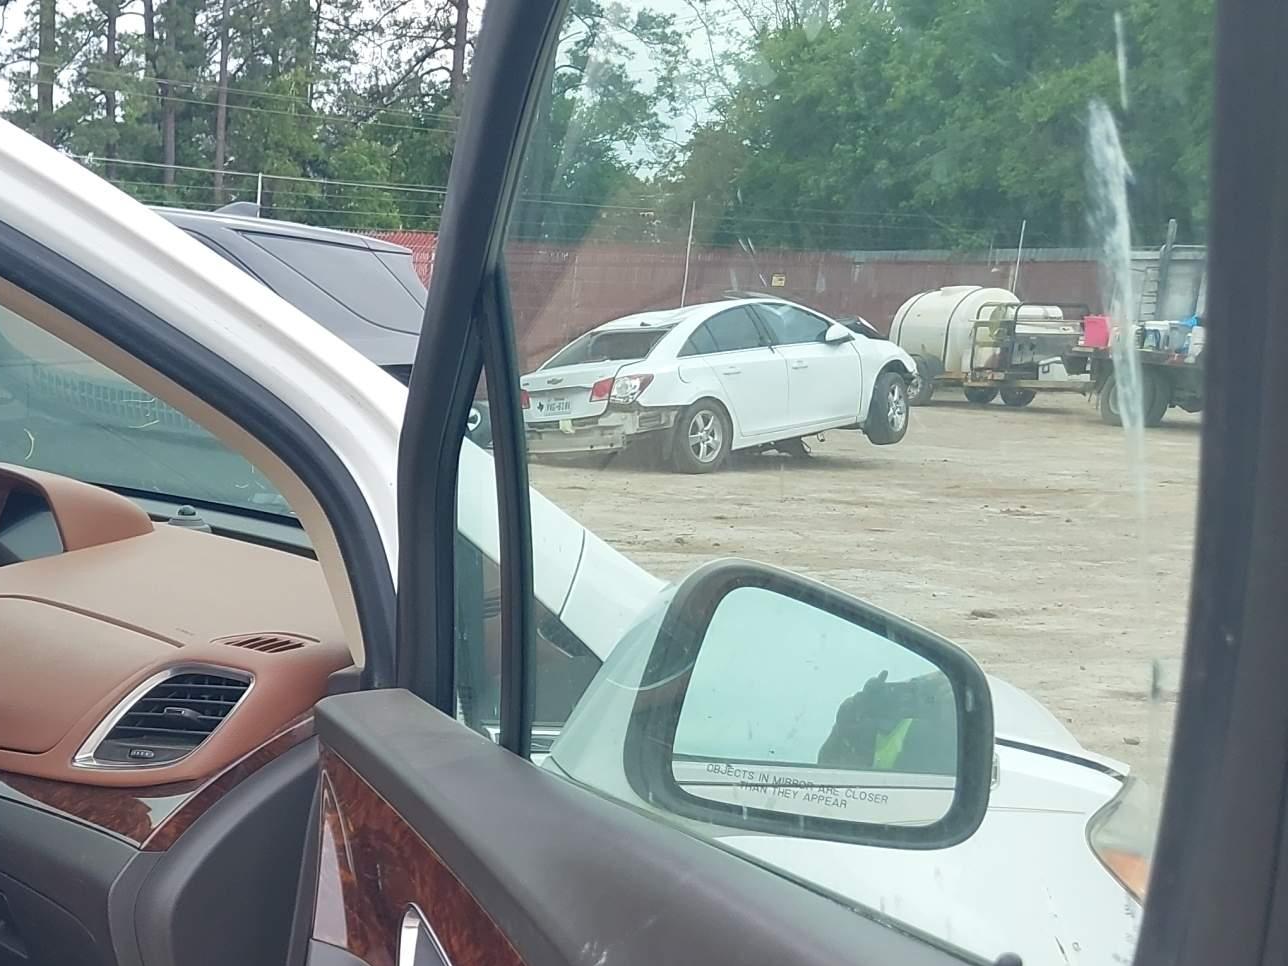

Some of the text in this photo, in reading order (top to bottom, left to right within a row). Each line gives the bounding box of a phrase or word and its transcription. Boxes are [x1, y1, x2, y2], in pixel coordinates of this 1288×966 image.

[706, 763, 889, 805] OBJECTS IN MIRROR ARE CLOSER
[739, 780, 848, 809] THAN THEY APPEAR
